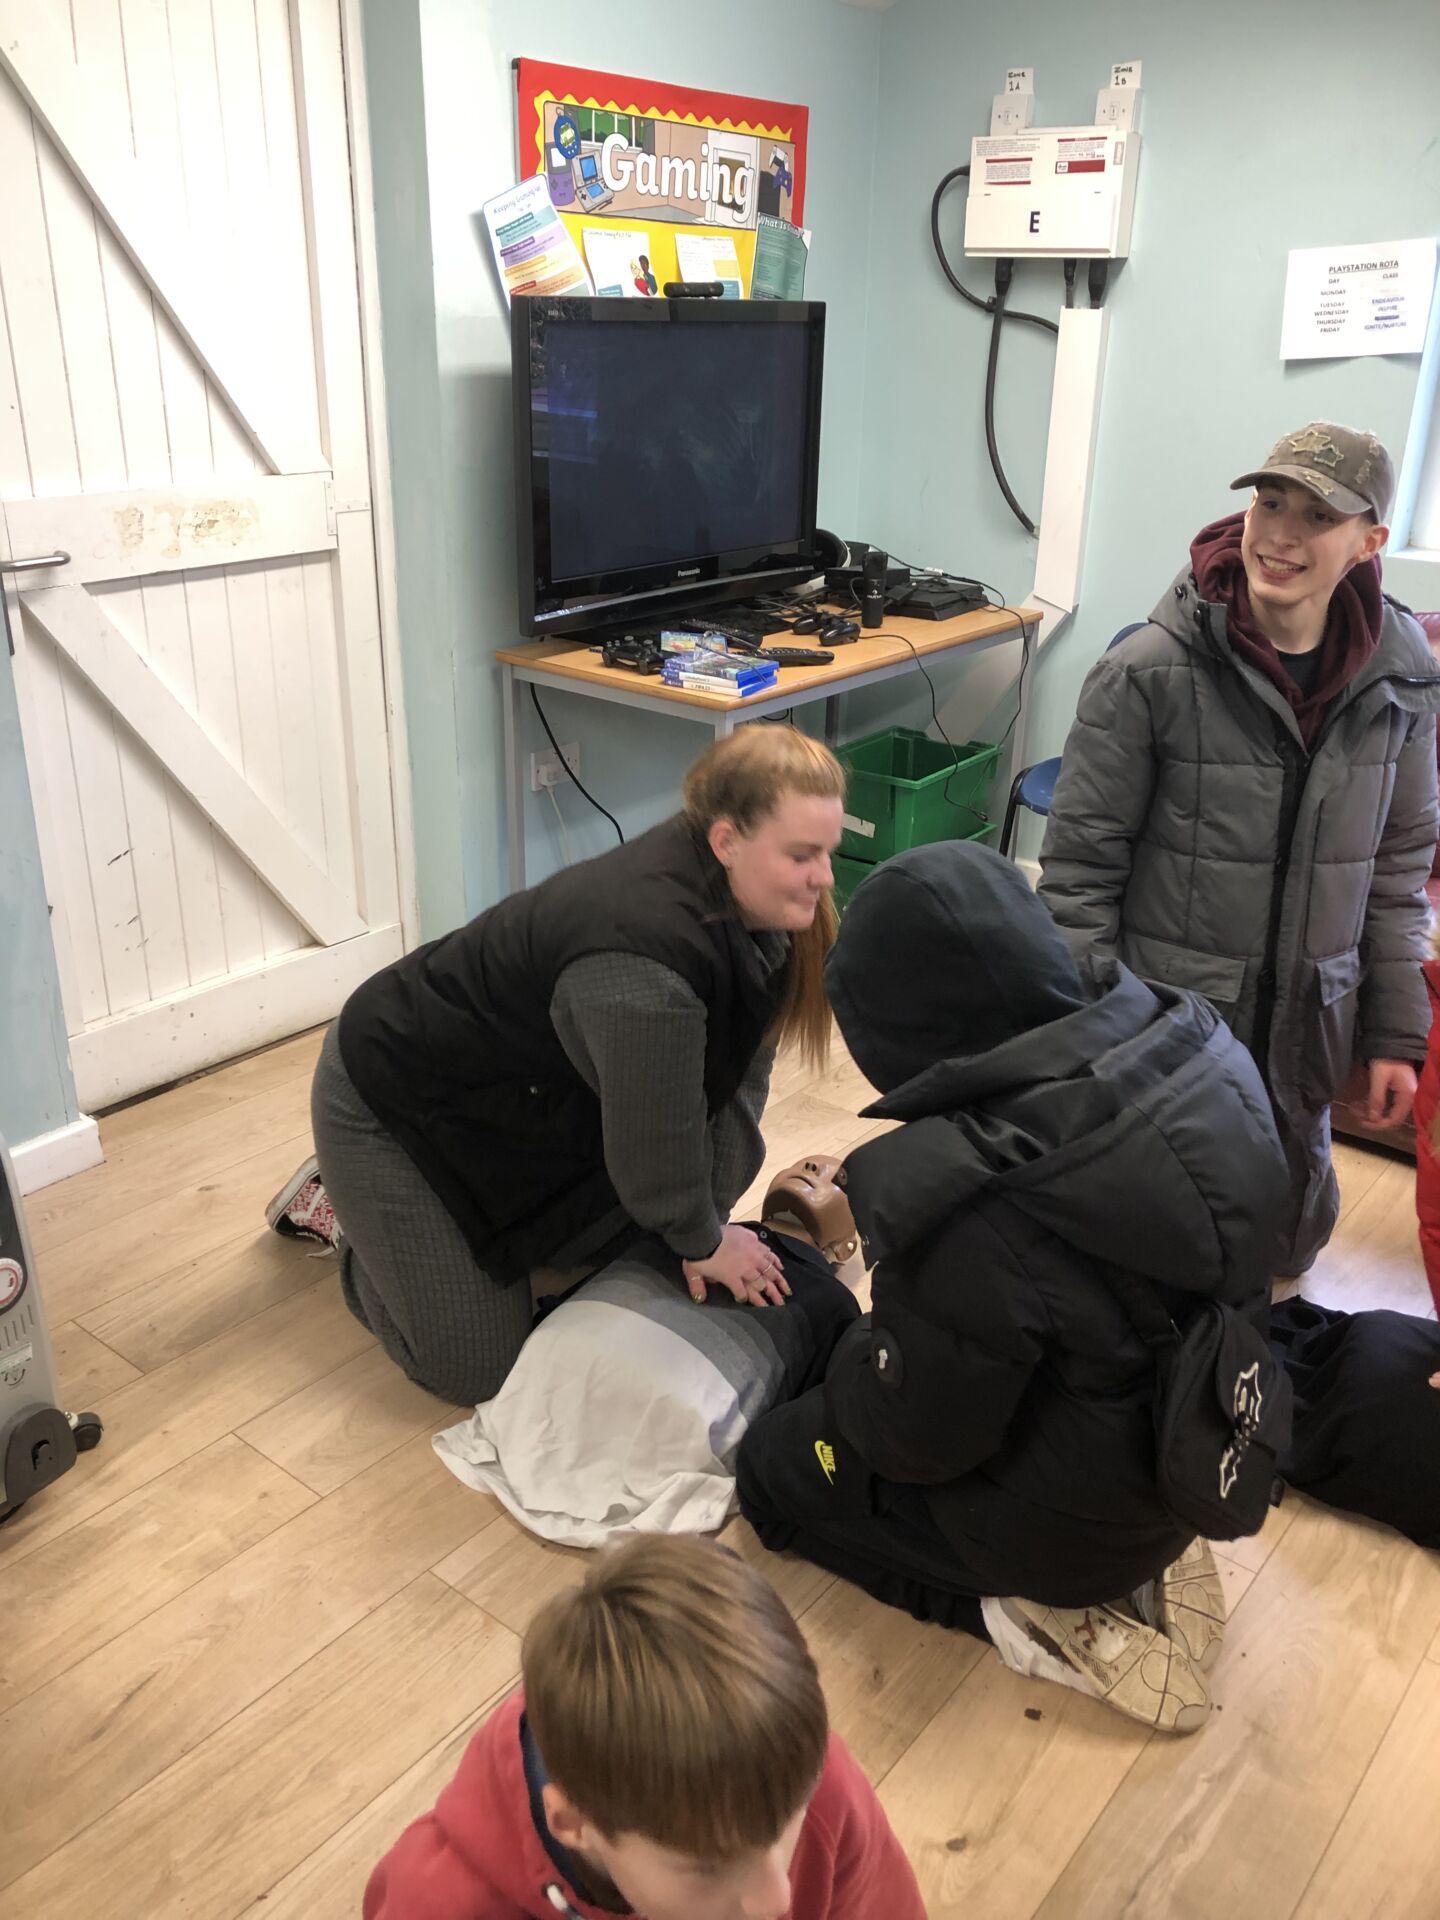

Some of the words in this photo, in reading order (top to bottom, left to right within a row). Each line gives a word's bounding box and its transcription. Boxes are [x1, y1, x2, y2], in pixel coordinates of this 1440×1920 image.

[601, 133, 755, 223] Gaming
[758, 212, 778, 229] What
[1029, 210, 1041, 233] E
[1328, 262, 1377, 274] PLAYSTATION
[1379, 260, 1399, 270] ROTA
[677, 568, 701, 577] Panasonic
[821, 1445, 836, 1472] NIKE
